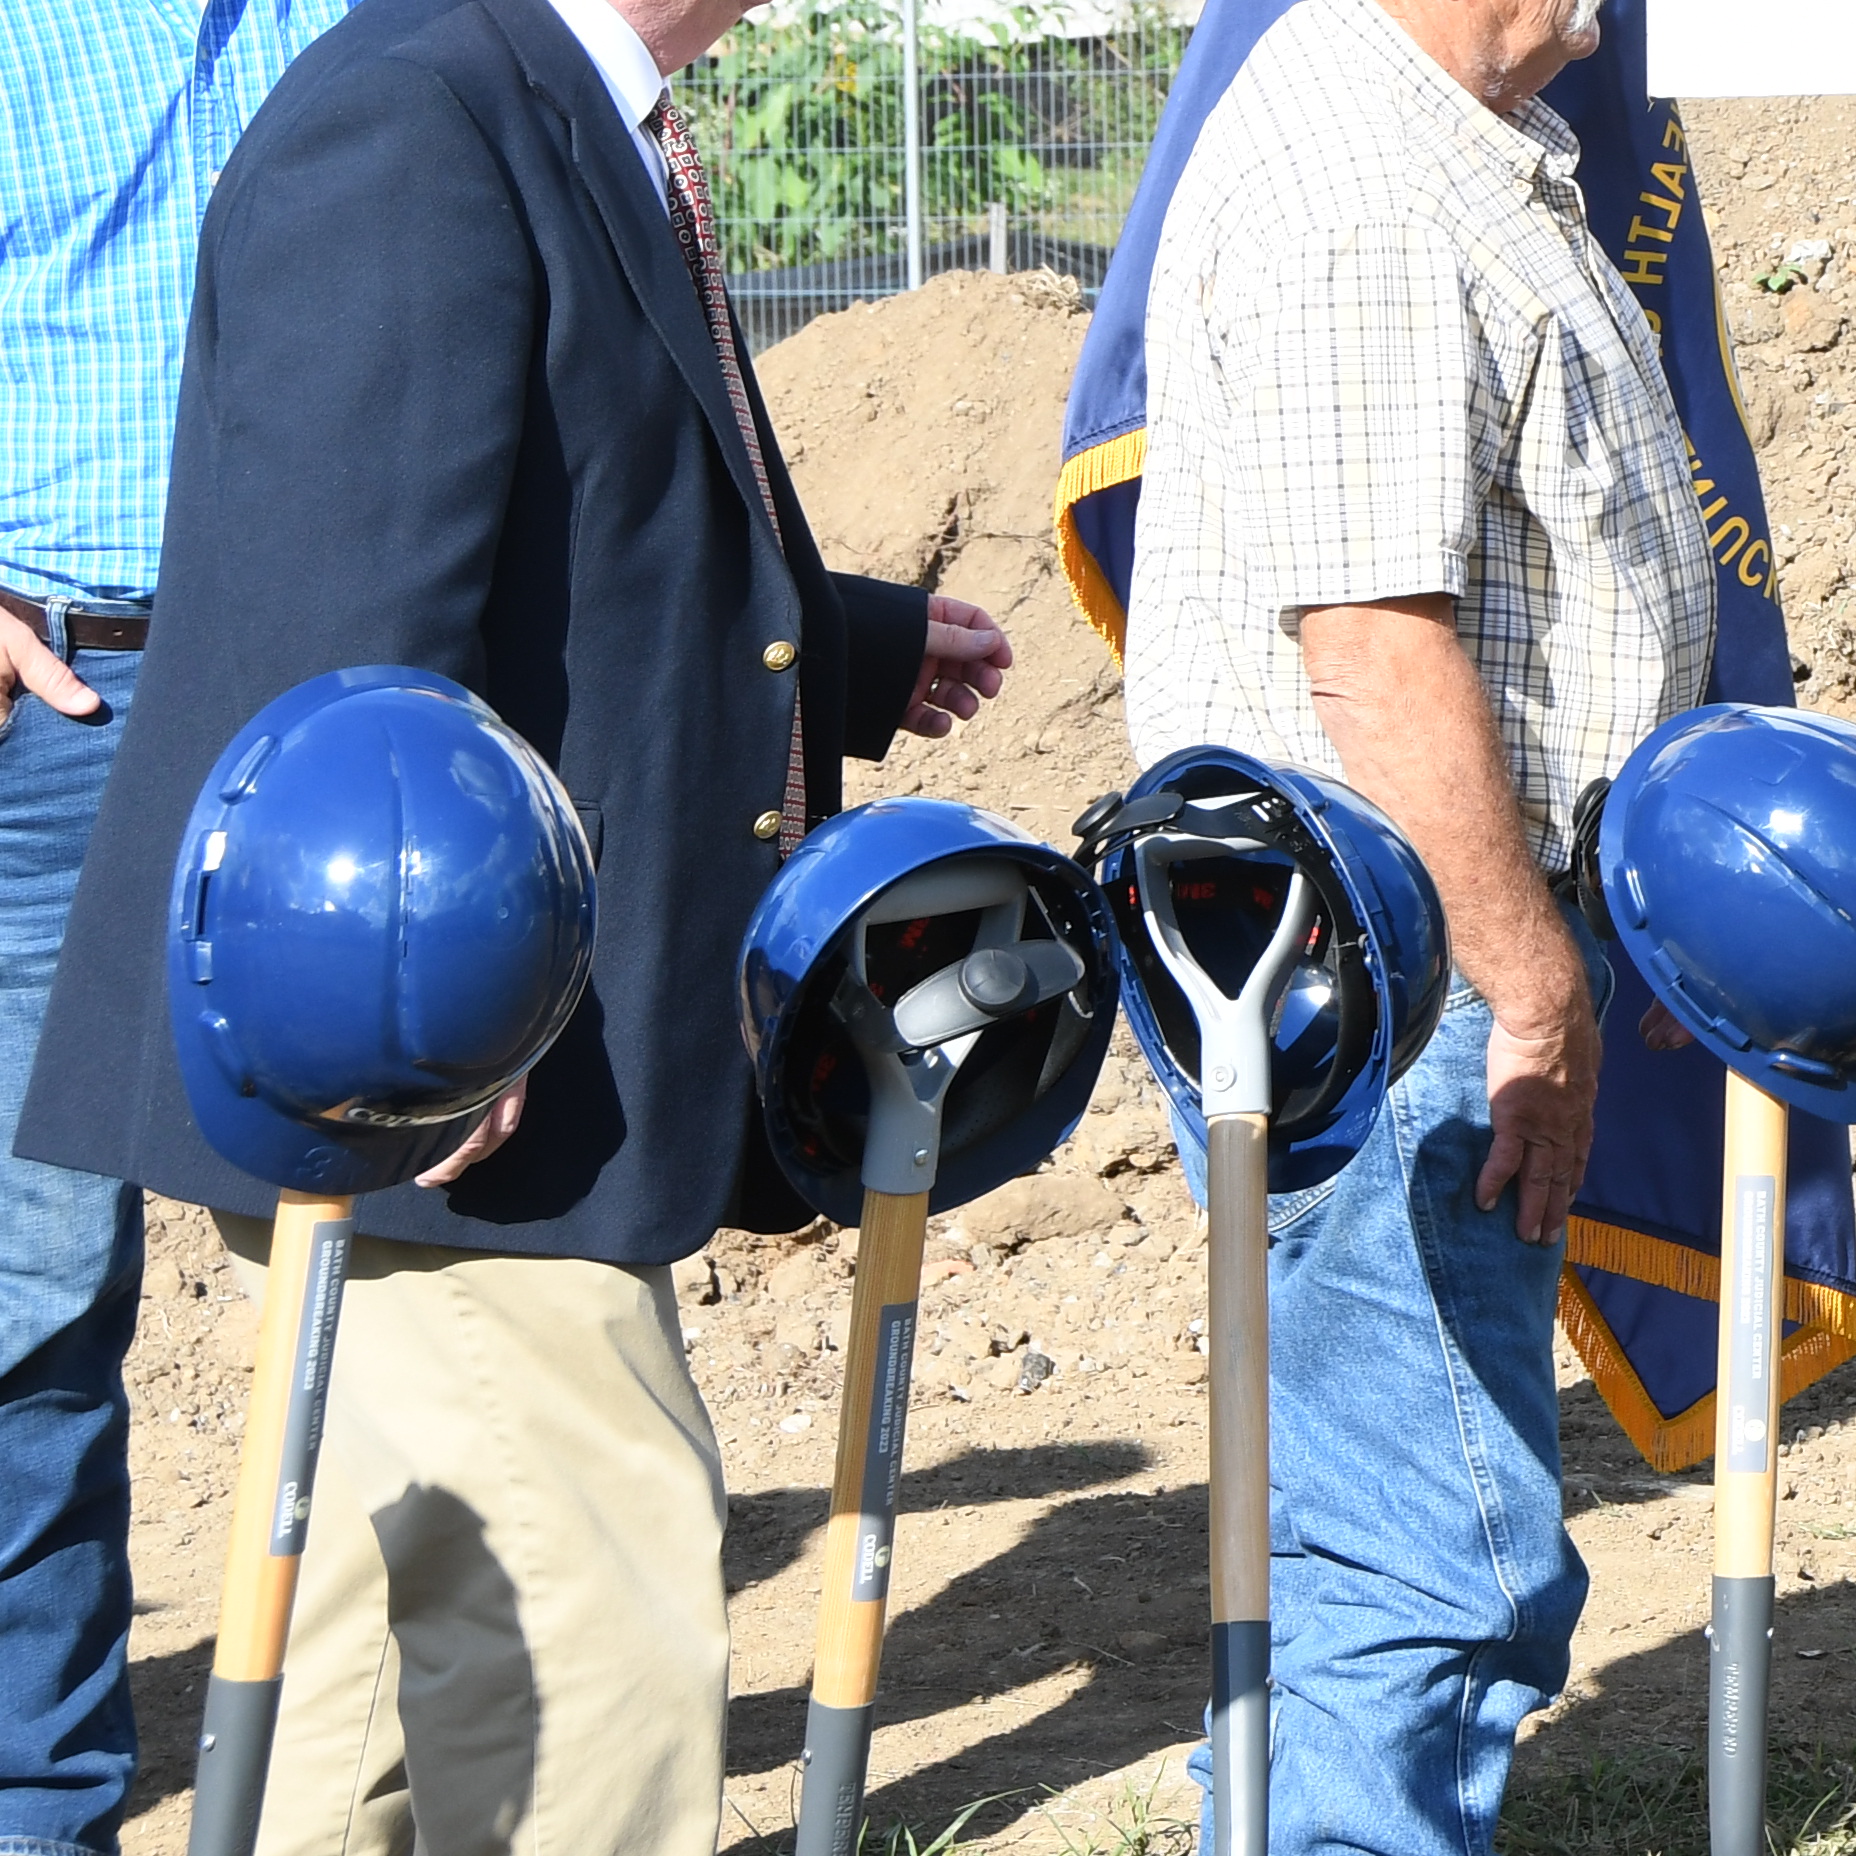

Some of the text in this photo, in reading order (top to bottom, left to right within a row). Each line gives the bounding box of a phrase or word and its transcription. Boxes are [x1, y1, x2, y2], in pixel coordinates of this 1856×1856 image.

[332, 1238, 346, 1277] BATH
[309, 1239, 334, 1361] GROUNDBREAKING
[326, 1277, 342, 1332] COUNTY
[878, 1320, 901, 1454] GROUNDBREAKING 2023
[279, 1481, 298, 1538] CODELL
[859, 1533, 877, 1586] CODELL
